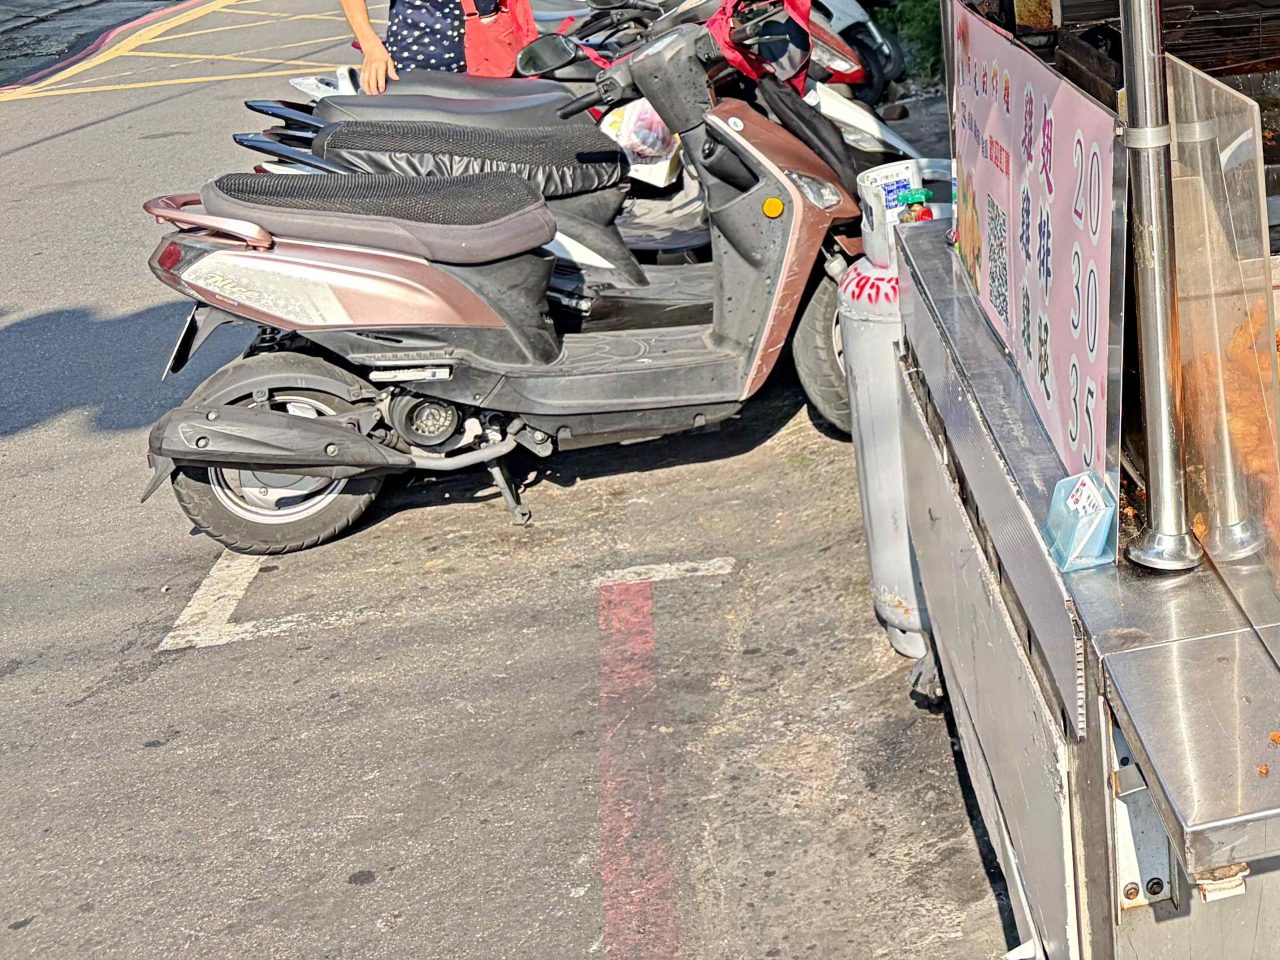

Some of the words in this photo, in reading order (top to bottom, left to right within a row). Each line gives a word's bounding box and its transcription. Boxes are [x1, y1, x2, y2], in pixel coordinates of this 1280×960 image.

[1074, 138, 1101, 236] 20
[1020, 186, 1052, 297] 雞排
[1072, 250, 1098, 353] 30
[1069, 363, 1096, 467] 35
